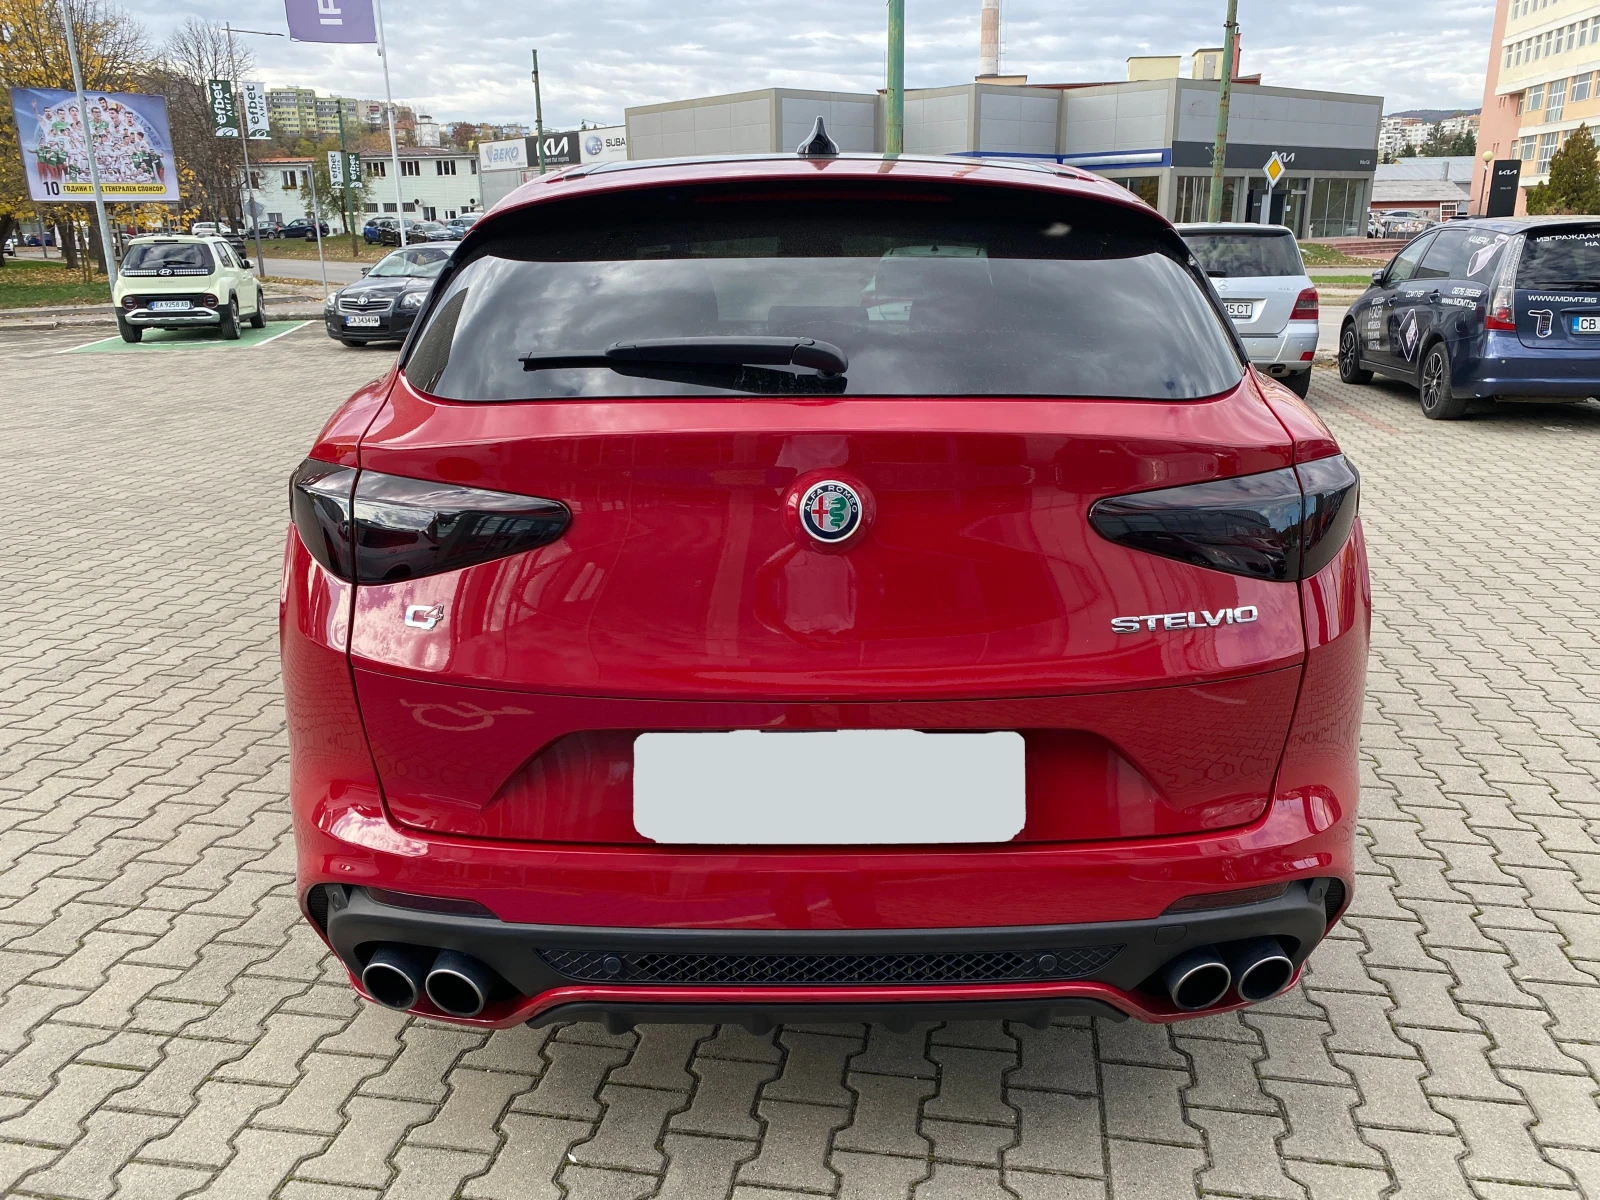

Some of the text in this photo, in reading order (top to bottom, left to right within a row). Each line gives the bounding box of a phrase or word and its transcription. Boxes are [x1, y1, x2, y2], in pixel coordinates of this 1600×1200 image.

[211, 83, 227, 125] efbet
[224, 93, 233, 117] ЛИГА
[245, 85, 260, 125] efbet
[257, 94, 266, 118] ЛИГА
[330, 153, 338, 178] efbet
[349, 154, 357, 180] efbet
[43, 181, 60, 196] 10
[63, 185, 88, 193] ГОДИНИ
[105, 184, 137, 193] ГЕНЕРАЛЕН
[137, 184, 164, 192] СПОНСОР
[1237, 304, 1251, 314] CT
[1527, 295, 1598, 304] WWW.MDMT.BG
[1581, 319, 1597, 330] CB
[804, 485, 858, 513] ALFA ROMEO
[1110, 605, 1259, 634] STELVIO
